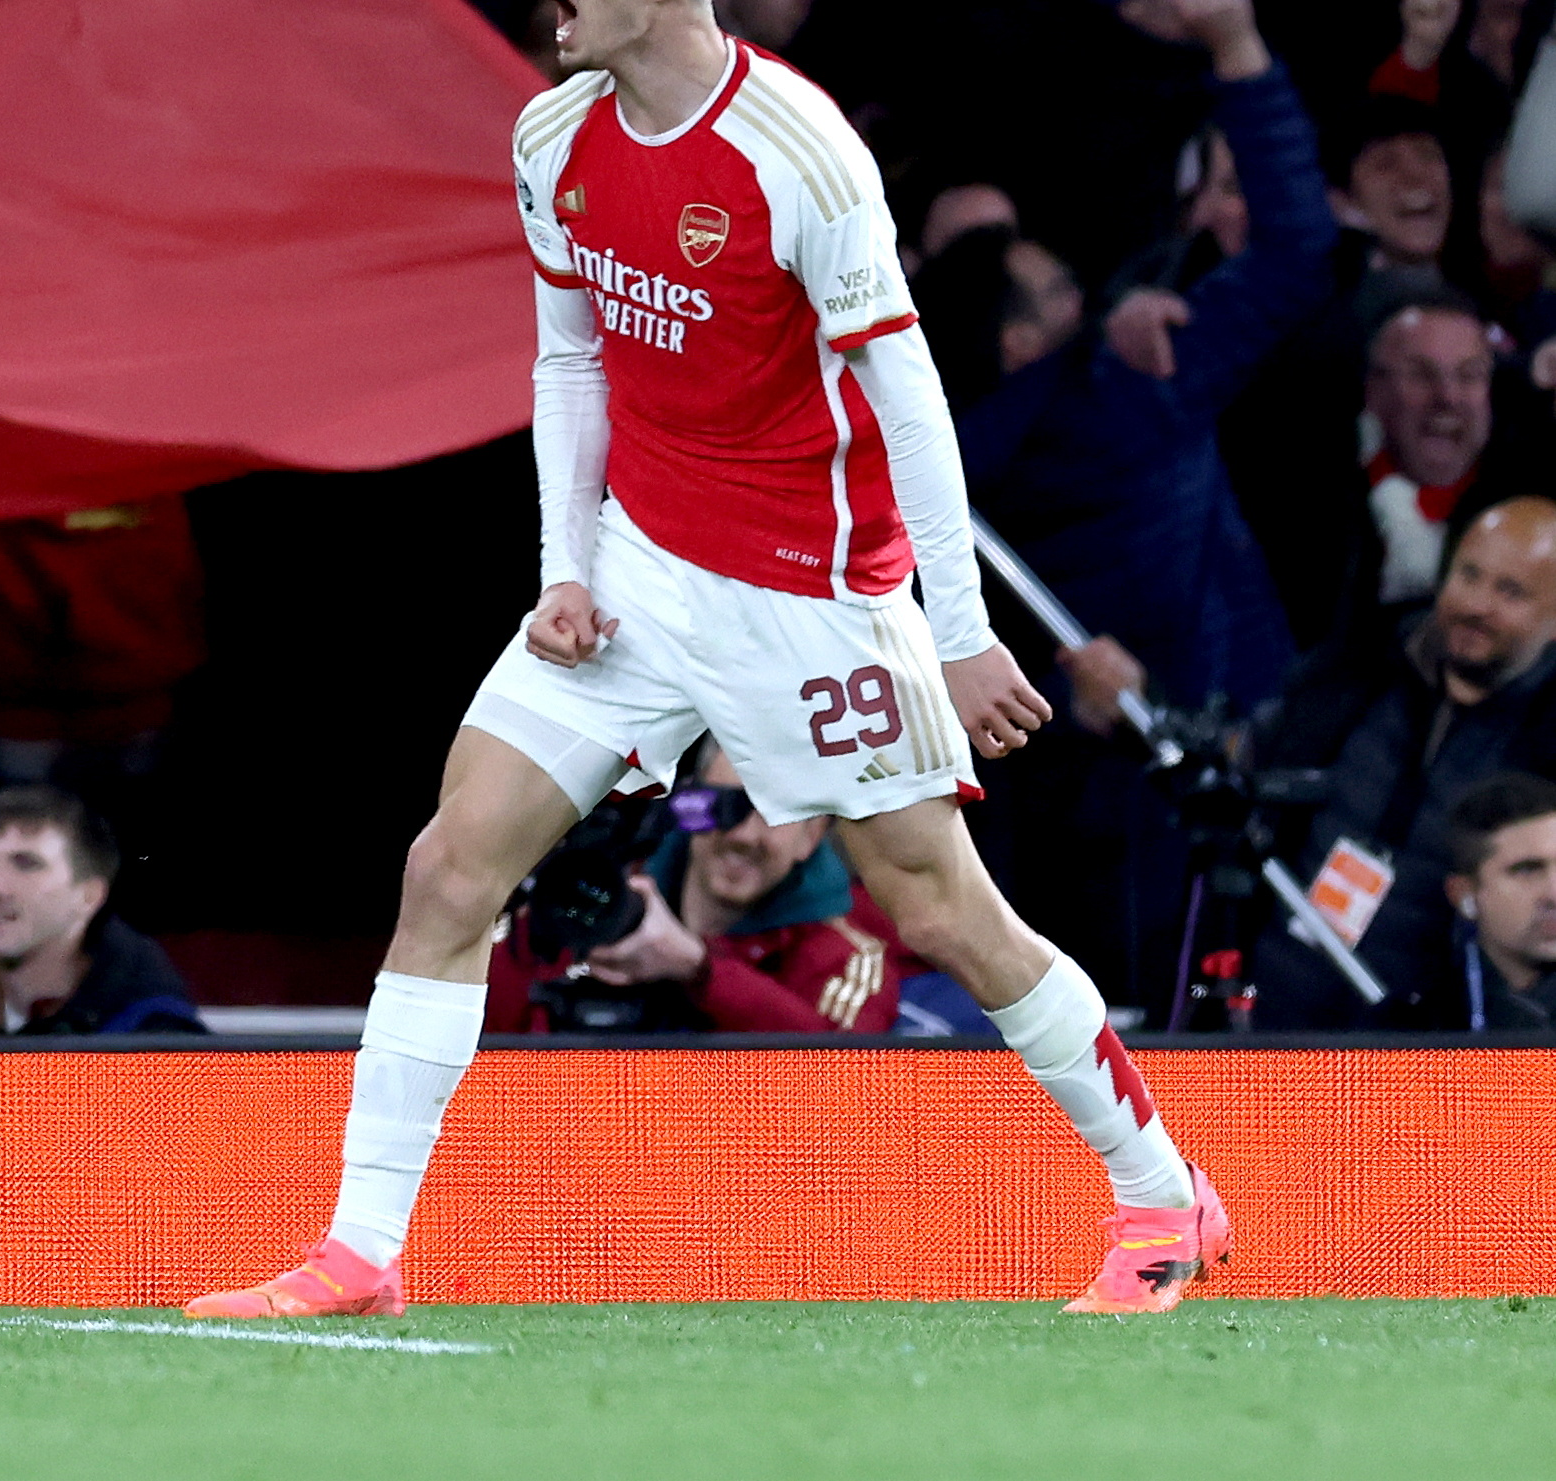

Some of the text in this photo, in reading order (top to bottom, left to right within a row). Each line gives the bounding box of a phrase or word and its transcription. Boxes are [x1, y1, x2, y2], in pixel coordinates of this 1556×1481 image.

[573, 240, 714, 322] mirates
[605, 298, 686, 355] BETTER
[800, 664, 903, 757] 29
